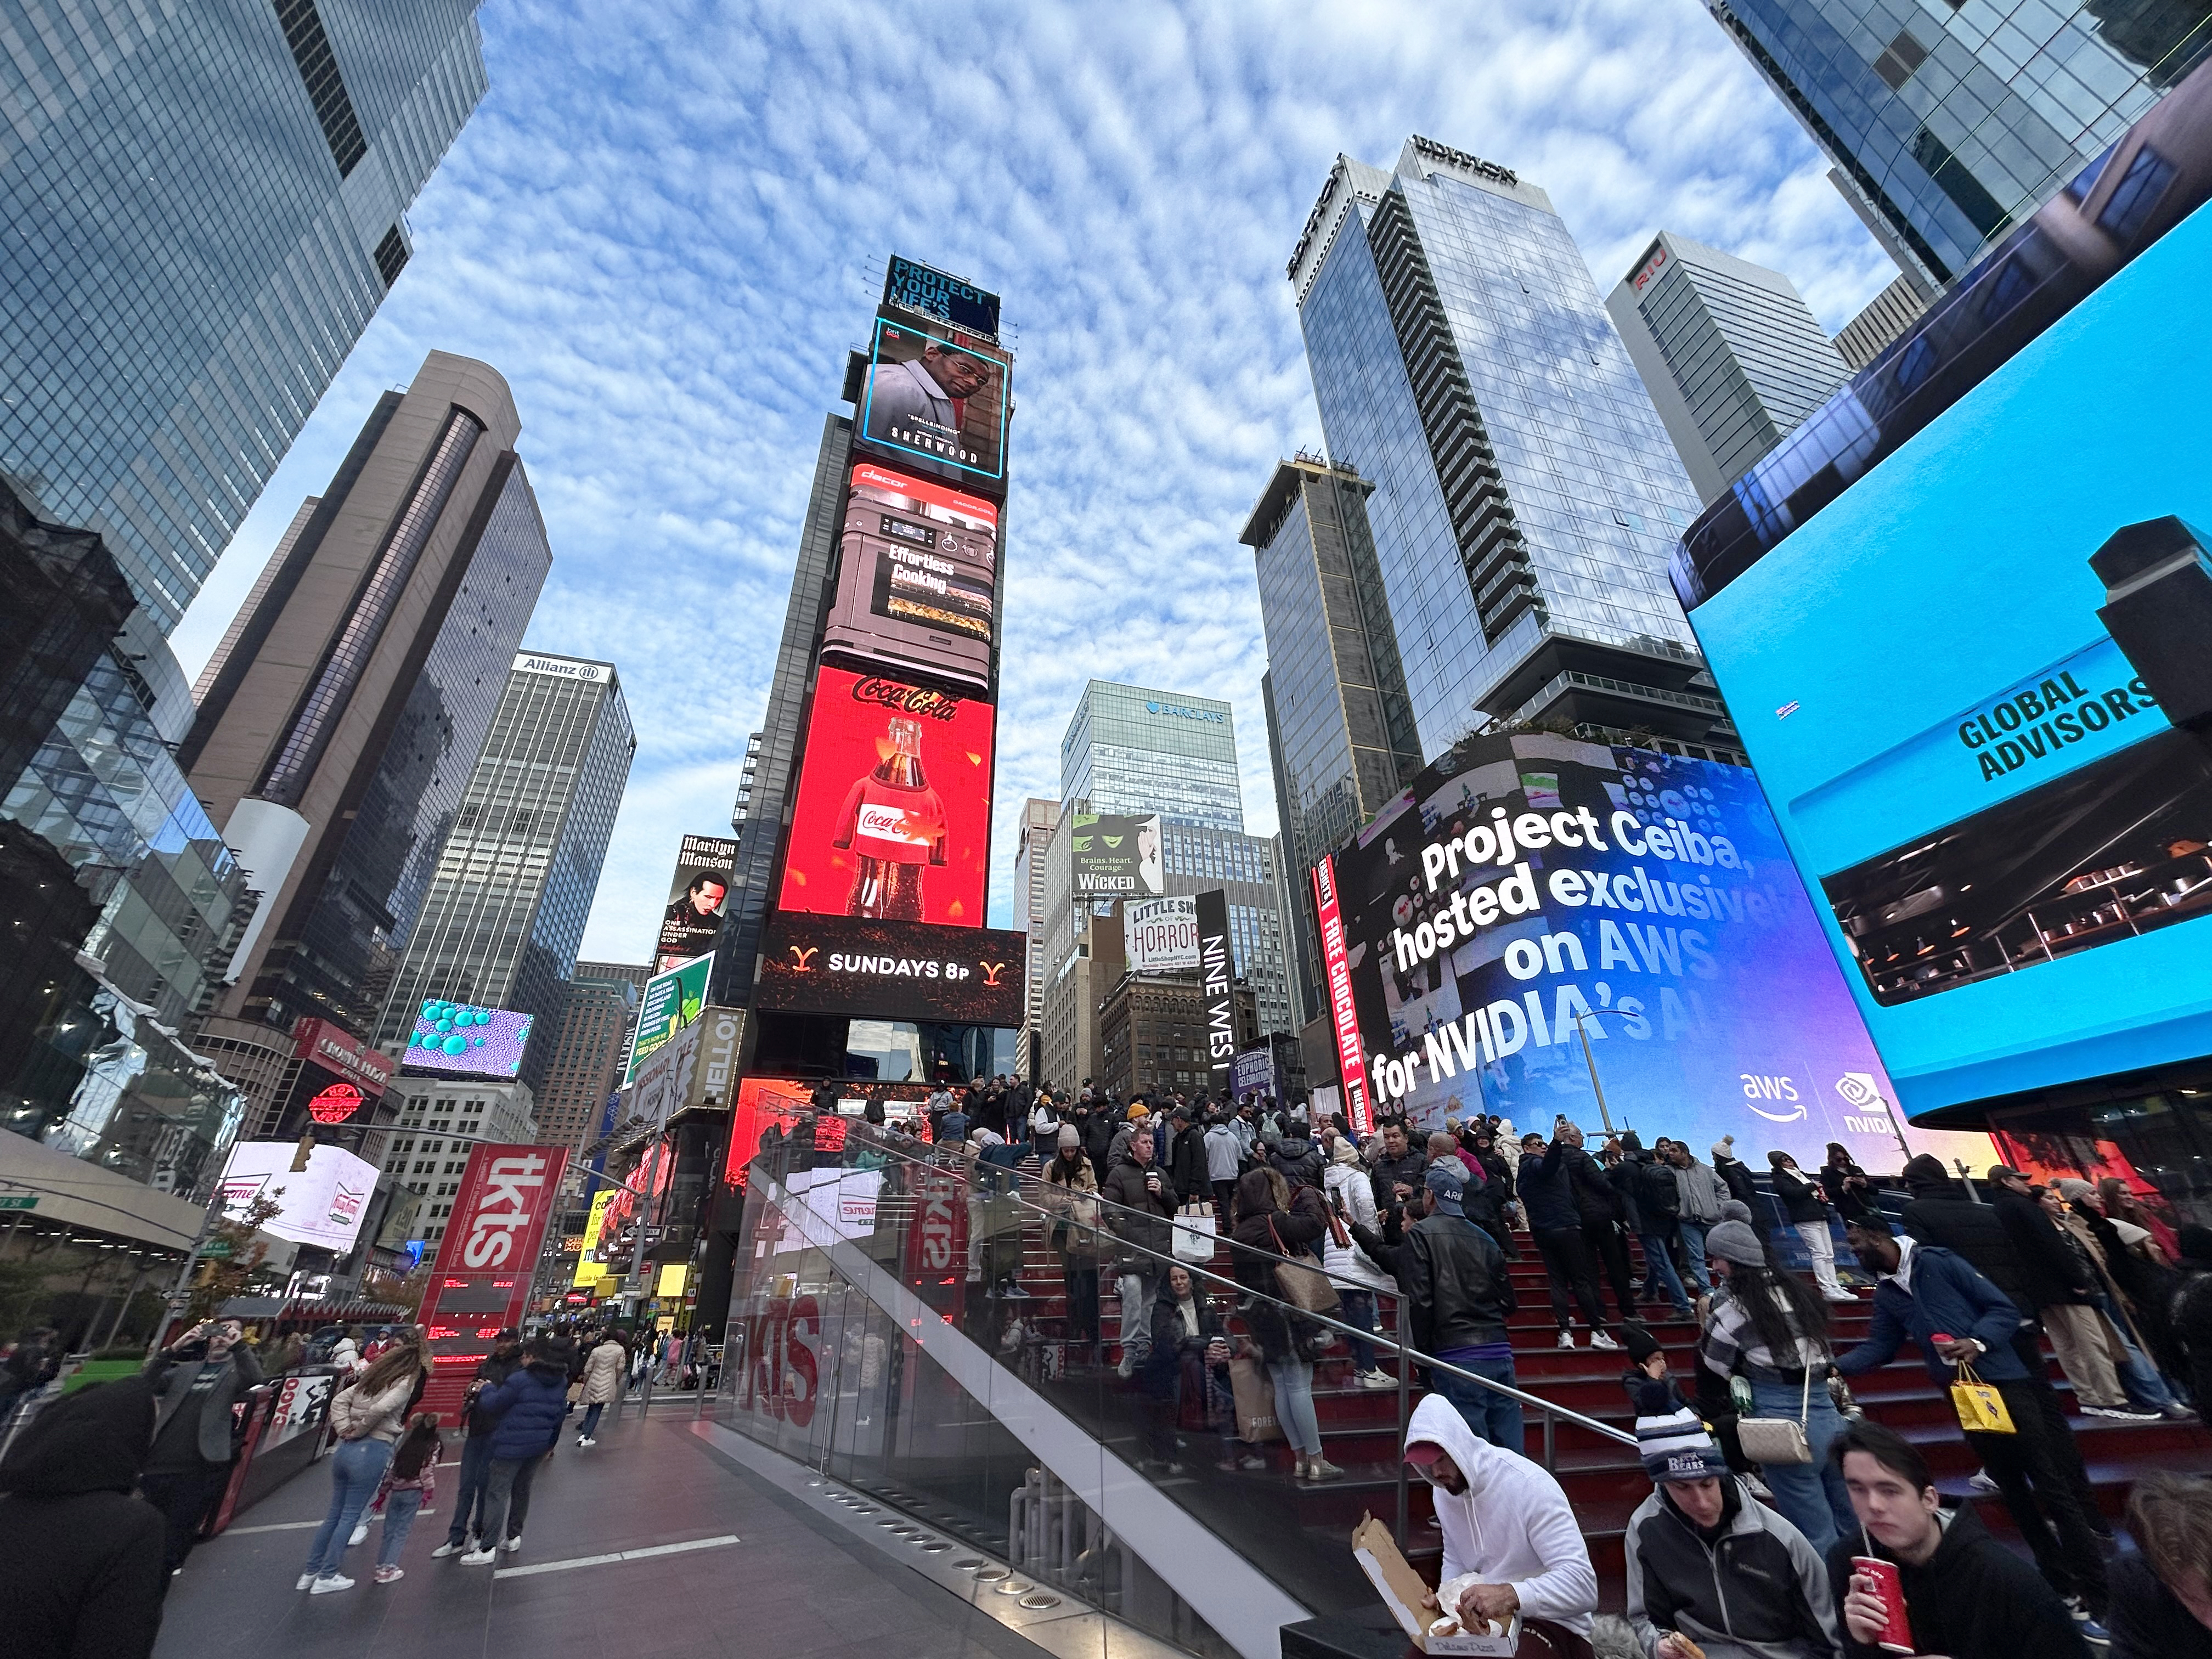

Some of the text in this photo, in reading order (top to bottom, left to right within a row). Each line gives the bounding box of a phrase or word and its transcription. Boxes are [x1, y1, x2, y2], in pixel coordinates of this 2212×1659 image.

[1412, 134, 1517, 183] EDITION
[895, 259, 986, 305] PROTECT
[1636, 249, 1666, 290] RIU
[891, 285, 950, 319] LIFE'S
[894, 273, 950, 305] YOUR
[891, 427, 977, 464] SHERWOOD
[861, 470, 908, 489] dacor
[953, 499, 994, 517] DACOR.COM
[889, 544, 955, 575] Effortless
[893, 563, 947, 594] Cooking
[523, 658, 576, 675] Allianz
[852, 675, 963, 721] Coca-Cola
[1162, 704, 1224, 724] BARCLAYS
[1958, 670, 2089, 751] GLOBAL
[1976, 677, 2158, 783] ADVISORS
[680, 851, 733, 870] Manson
[683, 836, 736, 856] Marilyn
[1421, 806, 1754, 893] Project Ceiba,
[1089, 864, 1124, 872] Courage.
[1133, 900, 1175, 924] LITTLE
[1392, 861, 1542, 973] hosted
[828, 953, 939, 978] SUNDAYS
[945, 962, 969, 981] 8P
[1202, 934, 1228, 997] NINE
[1504, 919, 1719, 980] on AWS
[1324, 916, 1361, 1070] FREE CHOCOLATE
[1372, 1051, 1420, 1103] for
[1424, 981, 1652, 1084] NVIDIA's
[1740, 1074, 1799, 1101] aws
[464, 1153, 546, 1268] tkts
